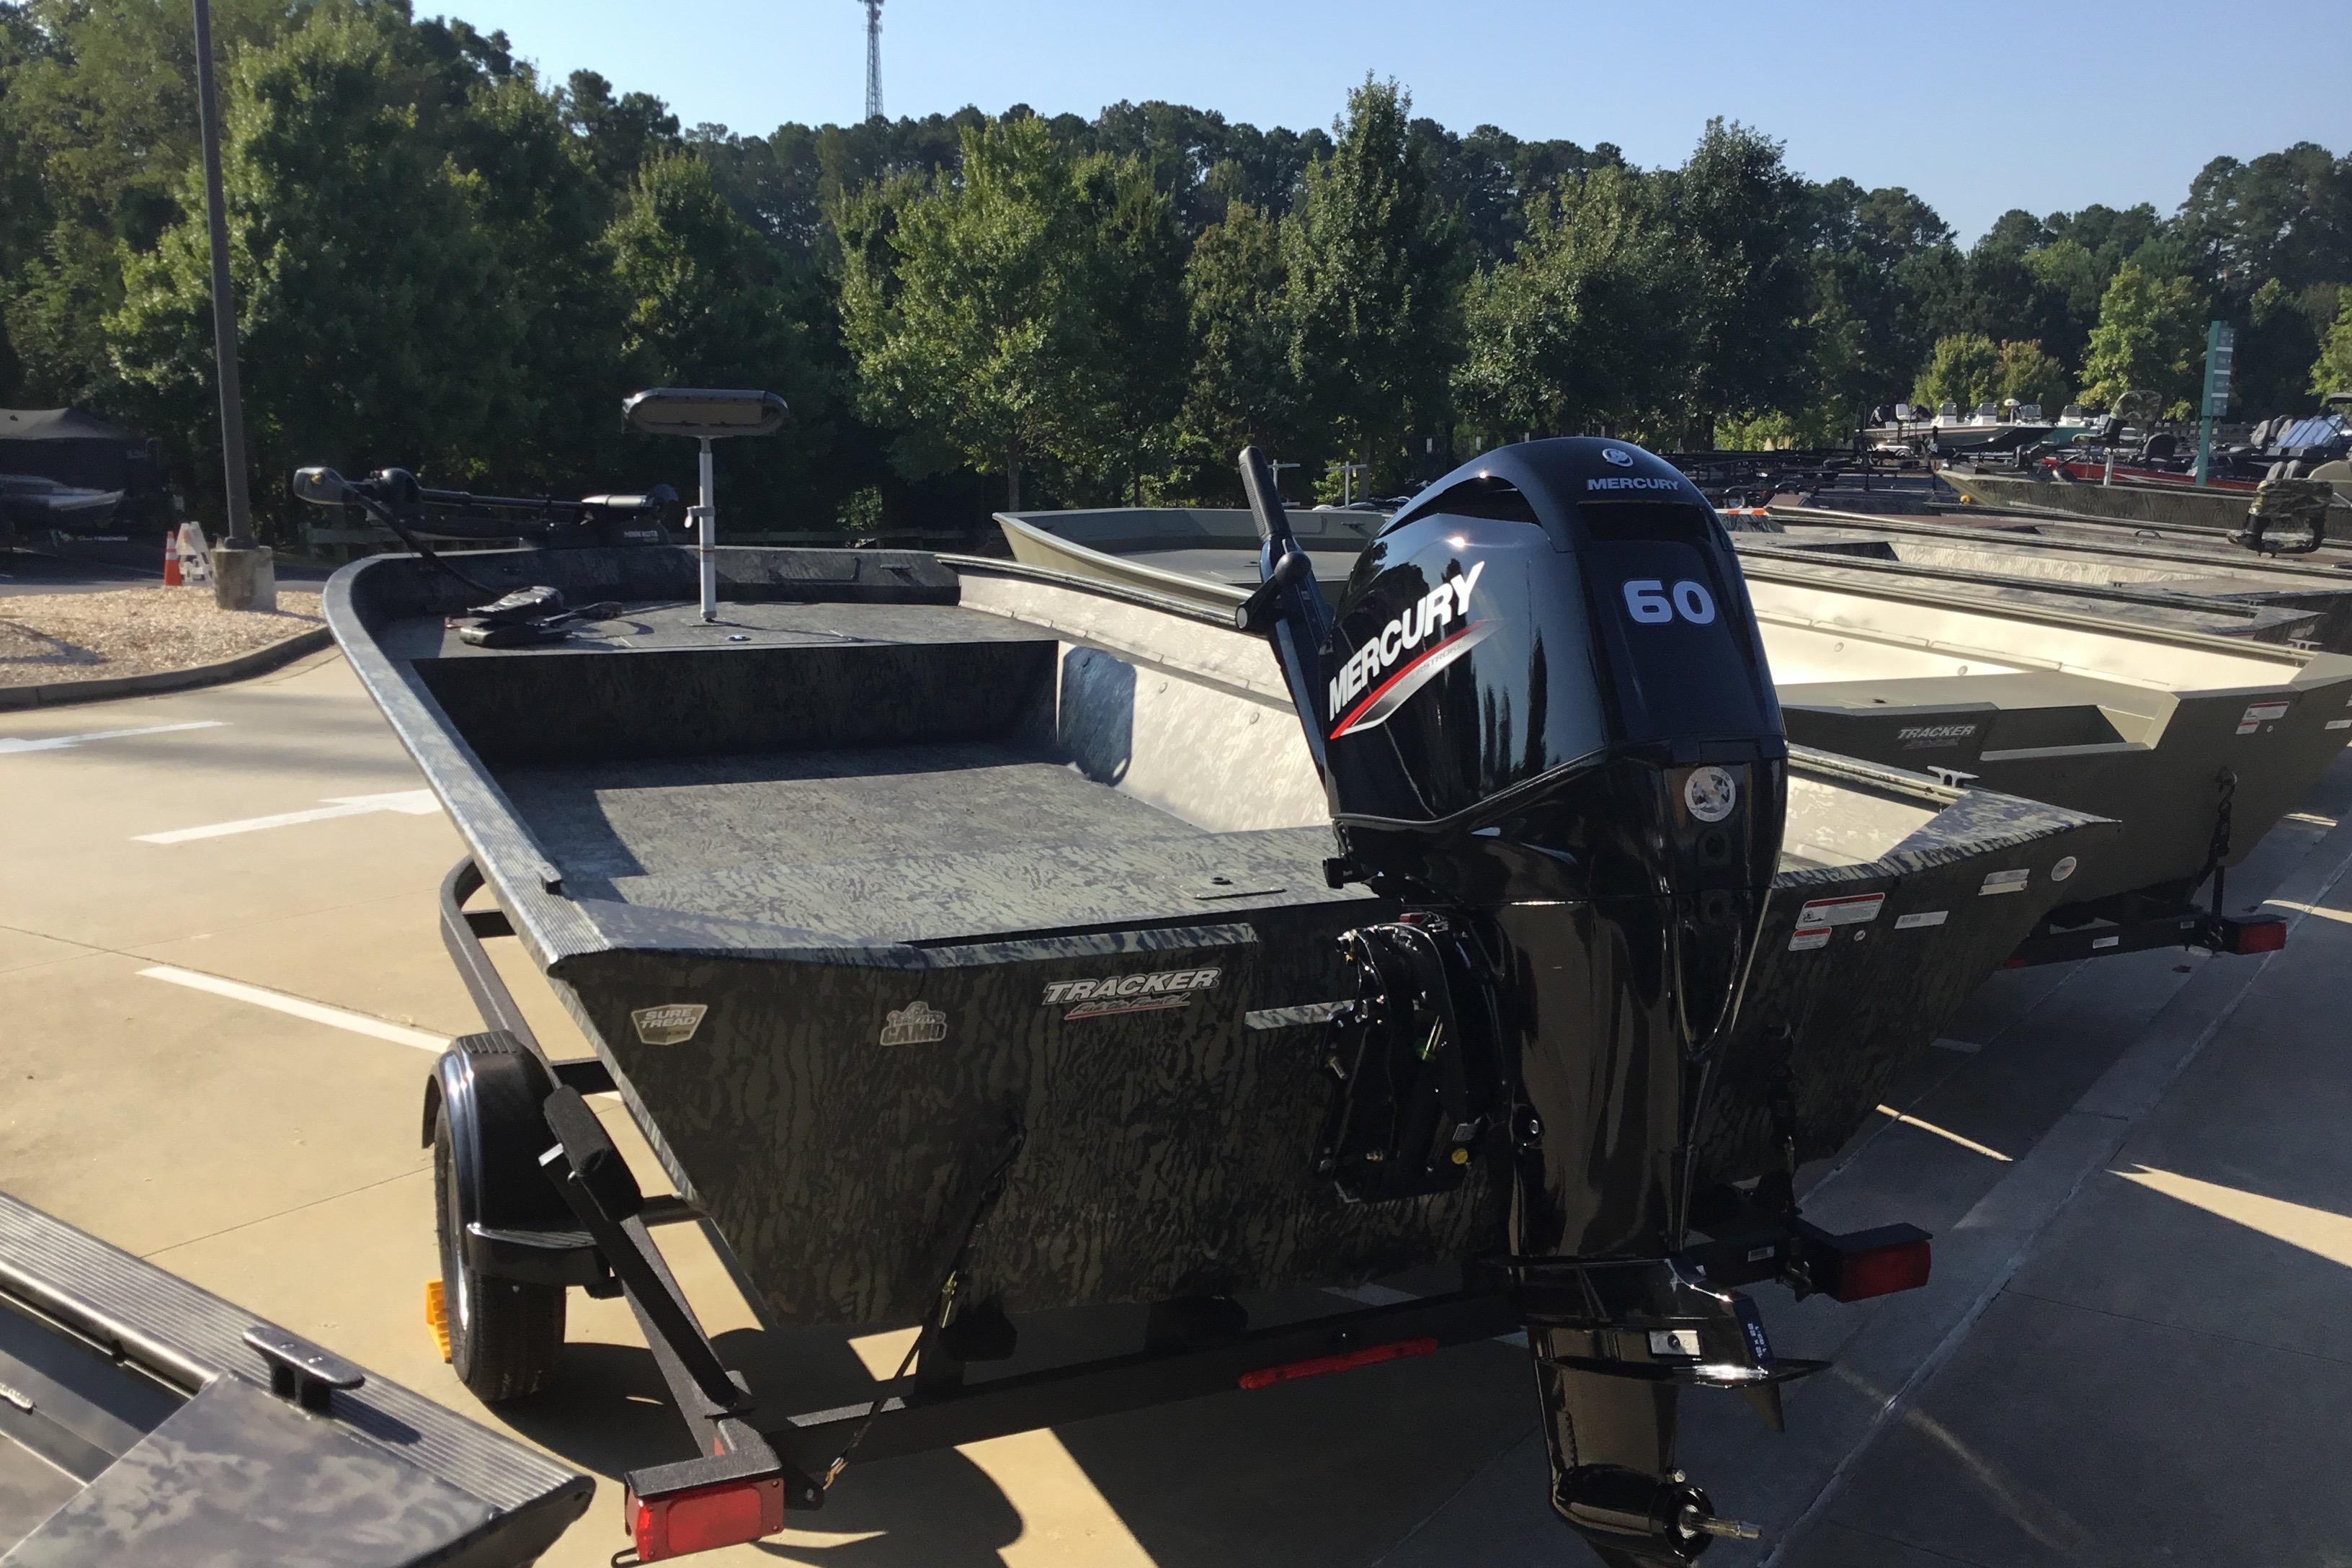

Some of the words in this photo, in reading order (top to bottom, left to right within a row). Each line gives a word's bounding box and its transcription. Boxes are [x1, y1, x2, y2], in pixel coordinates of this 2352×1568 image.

[1587, 478, 1678, 491] MERCURY
[1623, 579, 1716, 625] 60
[1329, 561, 1485, 721] MERCURY
[1897, 725, 1977, 739] TRACKER
[1045, 969, 1220, 1004] TRACKER
[641, 1017, 697, 1028] TREAD
[645, 1009, 692, 1020] SURE
[883, 1023, 945, 1043] CAMO
